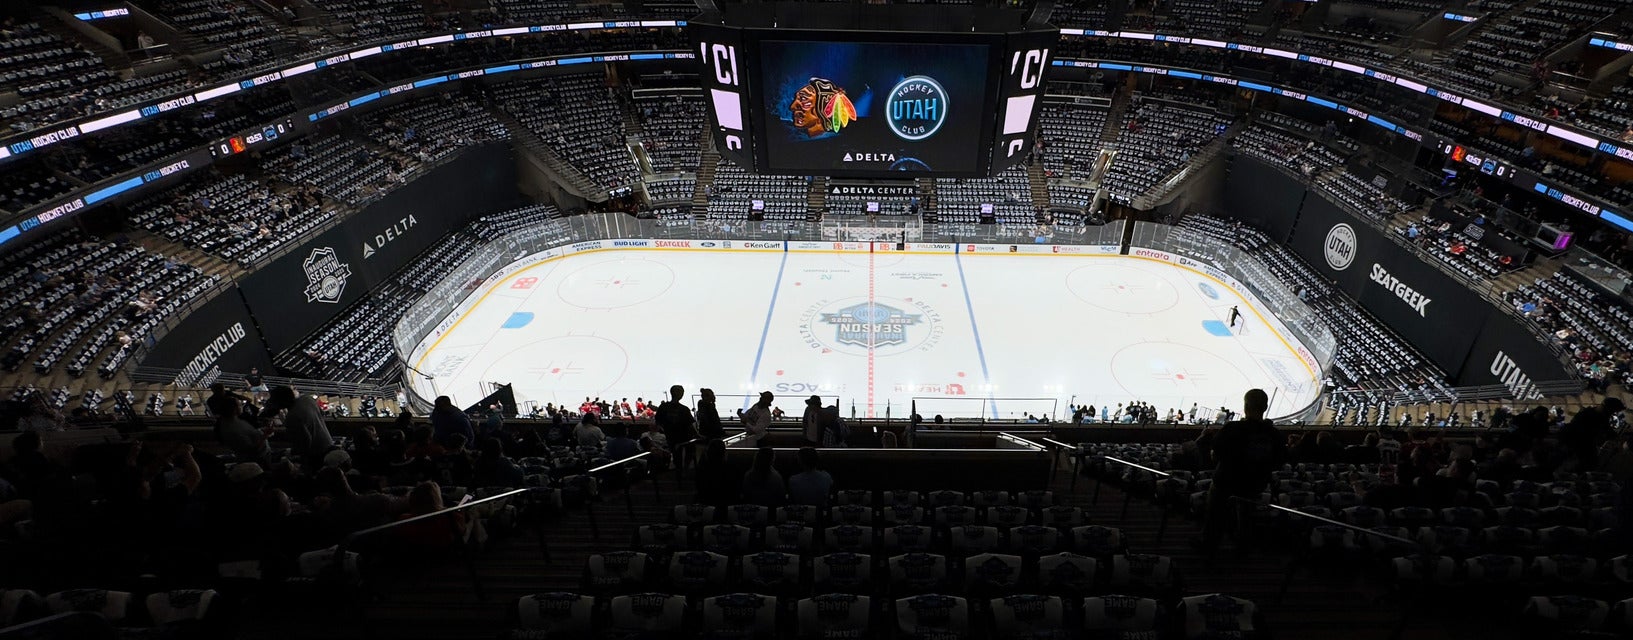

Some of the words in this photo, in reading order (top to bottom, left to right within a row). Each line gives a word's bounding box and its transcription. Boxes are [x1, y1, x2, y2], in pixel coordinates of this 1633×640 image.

[898, 84, 934, 97] HOCKEY
[142, 105, 159, 115] UTAH
[158, 100, 180, 111] HOCKEY
[180, 97, 195, 106] CLUB
[893, 98, 937, 120] UTAH
[902, 125, 925, 134] CLUB
[1501, 112, 1515, 122] UTAH
[1514, 116, 1533, 128] HOCKEY
[1532, 121, 1546, 131] CLUB
[11, 141, 33, 154] UTAH
[31, 132, 60, 148] HOCKEY
[59, 127, 79, 139] CLUB
[221, 144, 229, 154] 0
[246, 133, 262, 144] 43:53
[277, 124, 285, 133] 0
[1599, 142, 1616, 155] UTAH
[856, 153, 895, 161] DELTA
[1445, 145, 1451, 154] 0
[1497, 166, 1505, 176] 0
[144, 169, 161, 181] UTAH
[160, 163, 182, 176] HOCKEY
[1548, 189, 1563, 201] UTAH
[1561, 194, 1583, 208] HOCKEY
[1582, 202, 1599, 214] CLUB
[20, 217, 39, 231] UTAH
[38, 208, 66, 224] HOCKEY
[66, 199, 84, 211] CLUB
[375, 214, 417, 248] DELTA
[1336, 229, 1352, 243] HOCKEY
[1136, 249, 1169, 260] entrata
[1329, 235, 1352, 260] UTAH
[307, 254, 334, 274] INAUGURAL
[1329, 255, 1342, 266] CLUB
[310, 260, 338, 283] SEASON
[325, 281, 337, 293] UTAH
[1369, 263, 1432, 318] SEATGEEK
[440, 312, 460, 332] DELTA
[915, 301, 942, 323] DELTA
[800, 324, 821, 349] DELTA
[840, 324, 901, 333] SEASON
[842, 332, 902, 340] INAUGURAL
[1490, 350, 1531, 400] UTAH
